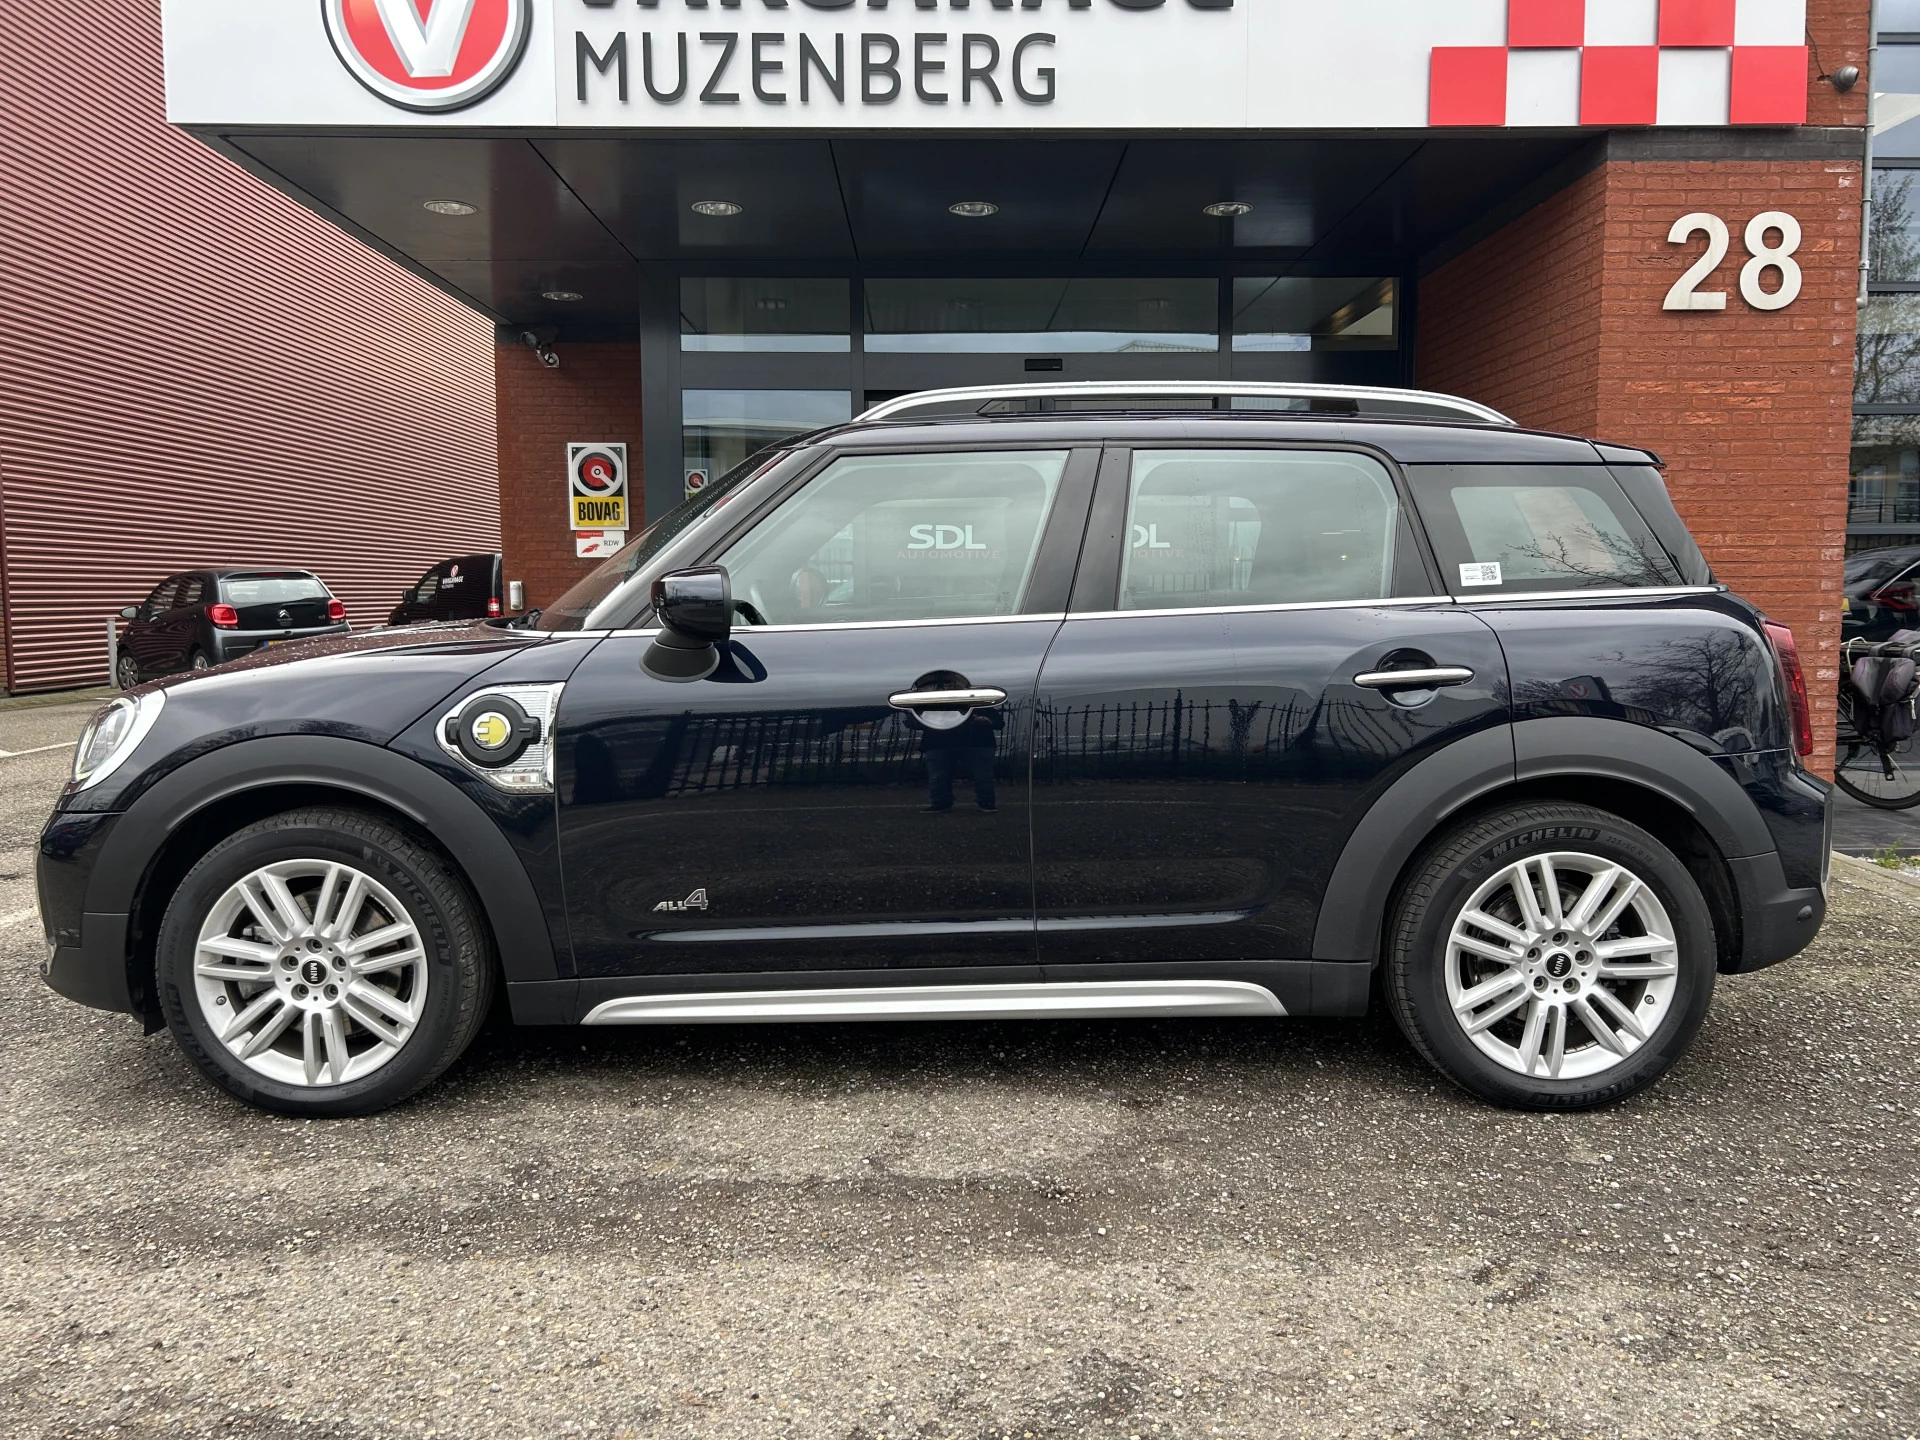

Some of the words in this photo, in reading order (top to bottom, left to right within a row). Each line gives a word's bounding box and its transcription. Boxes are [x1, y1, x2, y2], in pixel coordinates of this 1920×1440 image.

[575, 31, 1056, 105] MUZENBERG
[1662, 210, 1803, 311] 28
[577, 501, 621, 522] BOVAG
[907, 524, 987, 550] SDL
[897, 549, 1001, 560] AUTOMOTIVE
[1492, 827, 1597, 858] MICHELIN
[392, 870, 451, 962] MICHELIN
[310, 962, 319, 982] MINI
[1553, 955, 1566, 975] MINI
